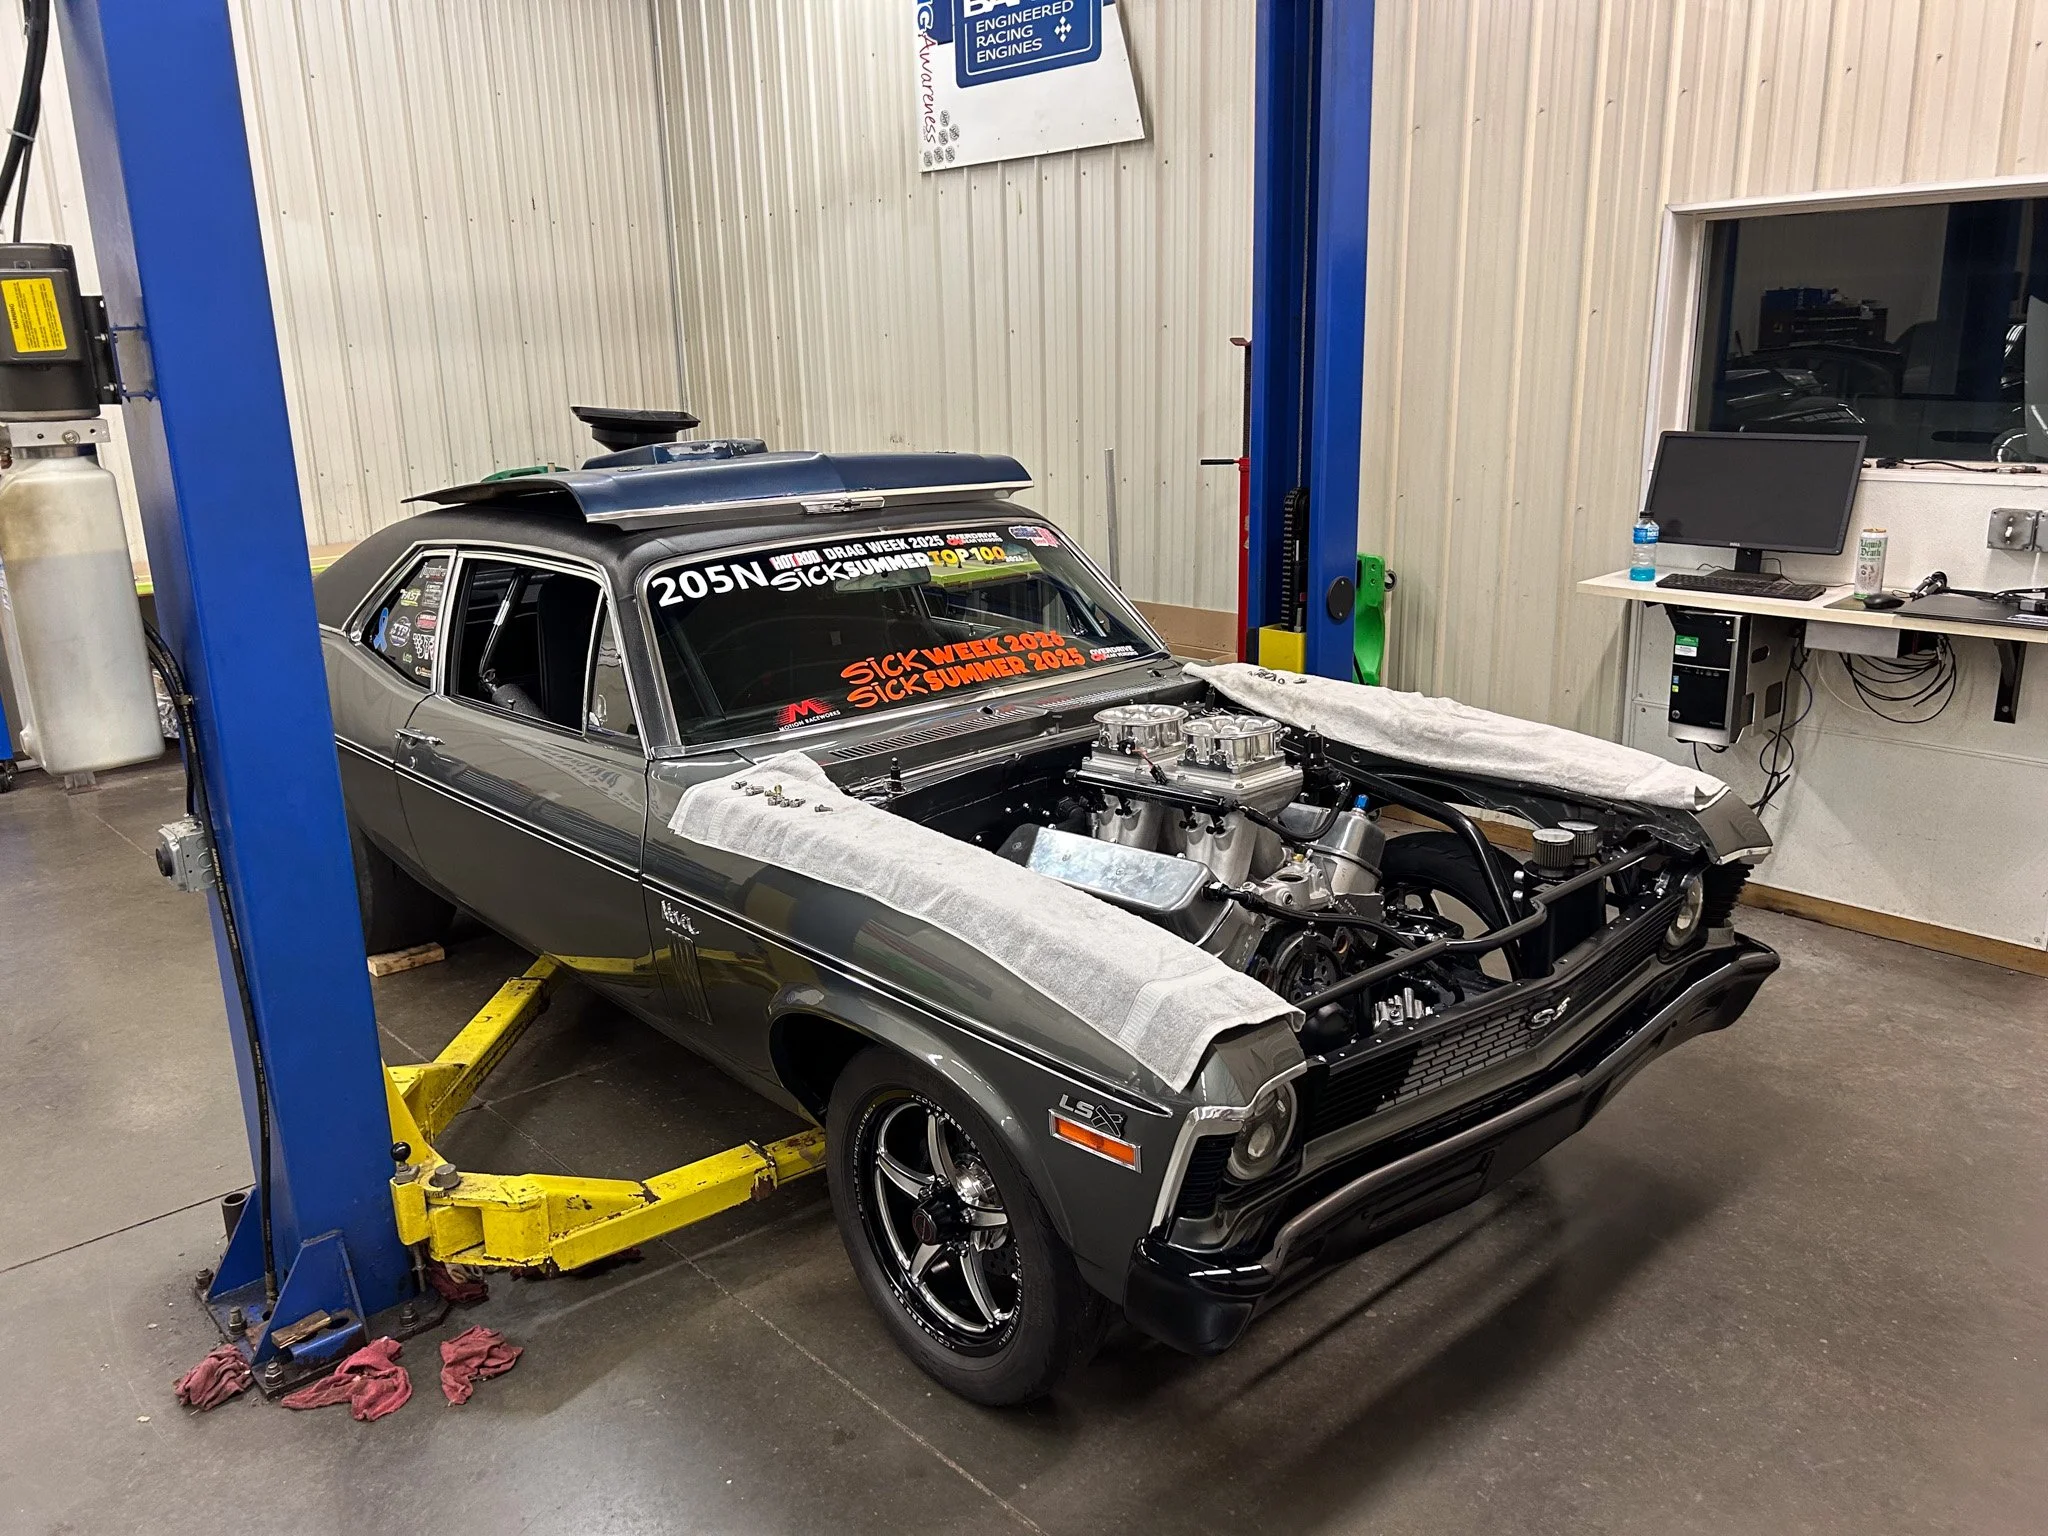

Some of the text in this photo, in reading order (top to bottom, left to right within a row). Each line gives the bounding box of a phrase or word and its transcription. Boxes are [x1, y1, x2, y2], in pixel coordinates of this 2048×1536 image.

[976, 0, 1074, 33] ENGINEERED
[976, 25, 1033, 49] RACING
[976, 38, 1043, 64] ENGINES
[918, 33, 938, 144] Awareness
[9, 304, 20, 329] WARNING
[946, 532, 999, 541] OVERDRIVE
[1860, 539, 1882, 549] Liquid
[769, 534, 944, 570] HOT ROD DRAG WEEK 2025
[926, 548, 969, 567] TOP
[968, 545, 1006, 561] 100
[1860, 547, 1881, 557] Death
[651, 561, 769, 607] 205N
[841, 629, 1066, 685] SICK WEEK 2026
[1090, 645, 1134, 655] OVERDRIVE
[847, 647, 1086, 708] SICK SUMMER 2025
[778, 709, 841, 732] MOTION RACEWORKS
